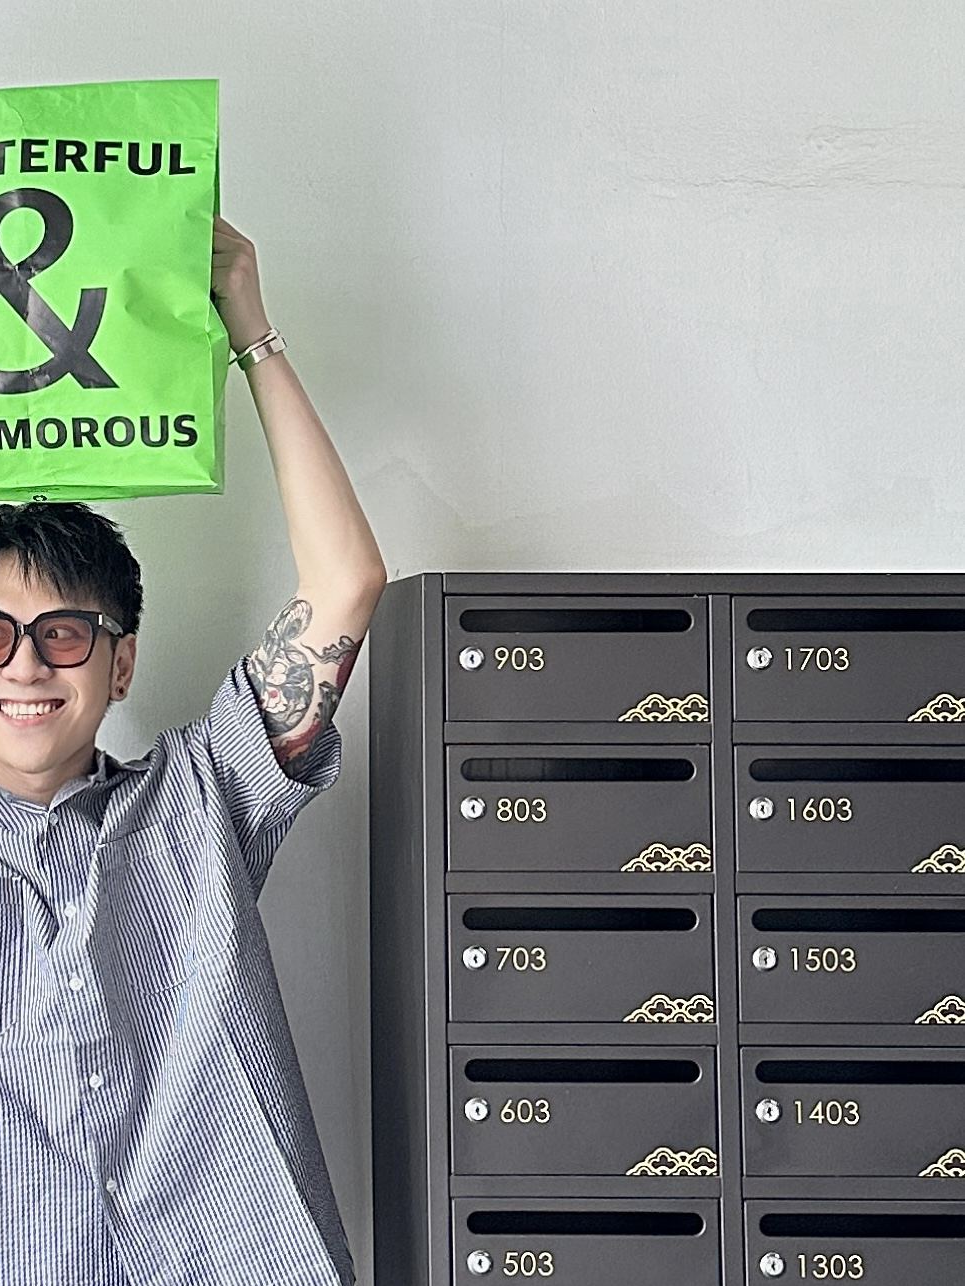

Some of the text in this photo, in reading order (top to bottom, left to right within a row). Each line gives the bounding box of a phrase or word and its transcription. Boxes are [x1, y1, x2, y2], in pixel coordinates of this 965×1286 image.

[494, 646, 545, 671] 903
[784, 647, 850, 671] 1703
[496, 798, 547, 822] 803
[787, 797, 853, 822] 1603
[496, 947, 547, 971] 703
[790, 947, 856, 972] 1503
[500, 1099, 551, 1124] 603
[794, 1100, 860, 1125] 1403
[503, 1251, 554, 1277] 503
[797, 1254, 864, 1279] 1303
